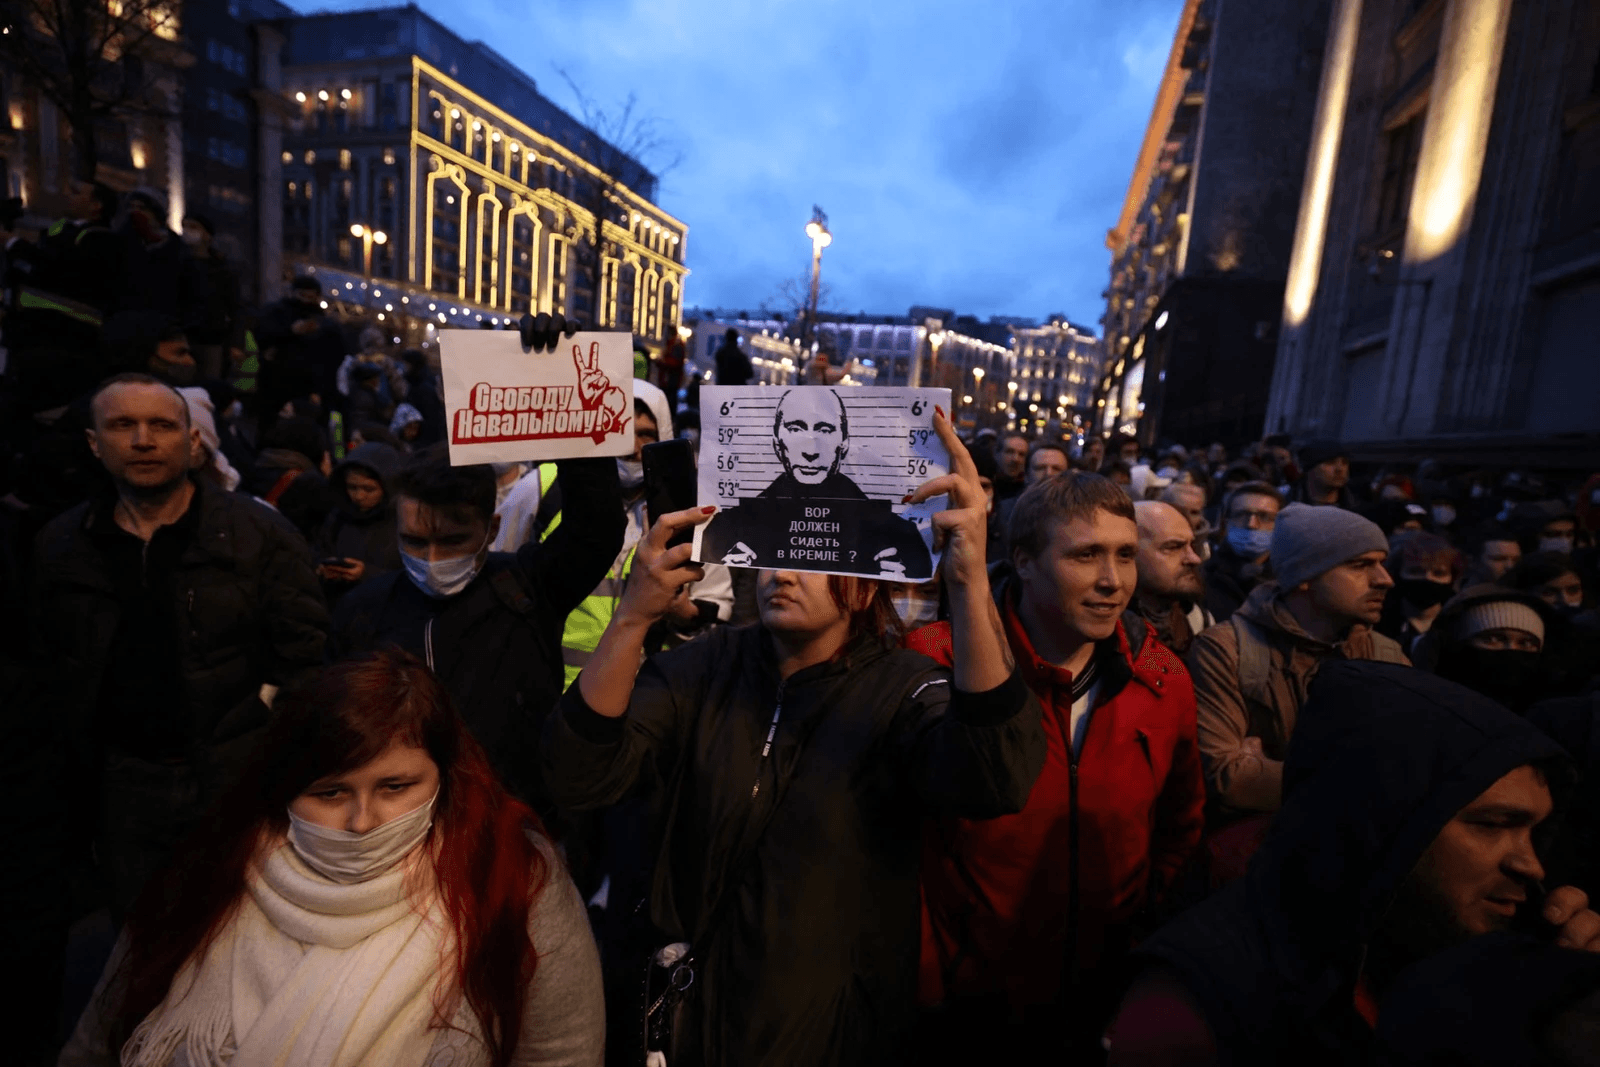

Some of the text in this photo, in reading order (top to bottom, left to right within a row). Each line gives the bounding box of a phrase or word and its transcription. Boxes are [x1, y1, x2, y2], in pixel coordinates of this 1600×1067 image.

[474, 382, 574, 412] Свободу
[456, 405, 605, 439] Навальному!
[804, 506, 831, 518] ВОР
[788, 520, 840, 533] ДОЛЖЕН
[789, 536, 840, 548] сидеть
[789, 548, 840, 562] КРЕМЛЕ
[848, 550, 858, 563] ?
